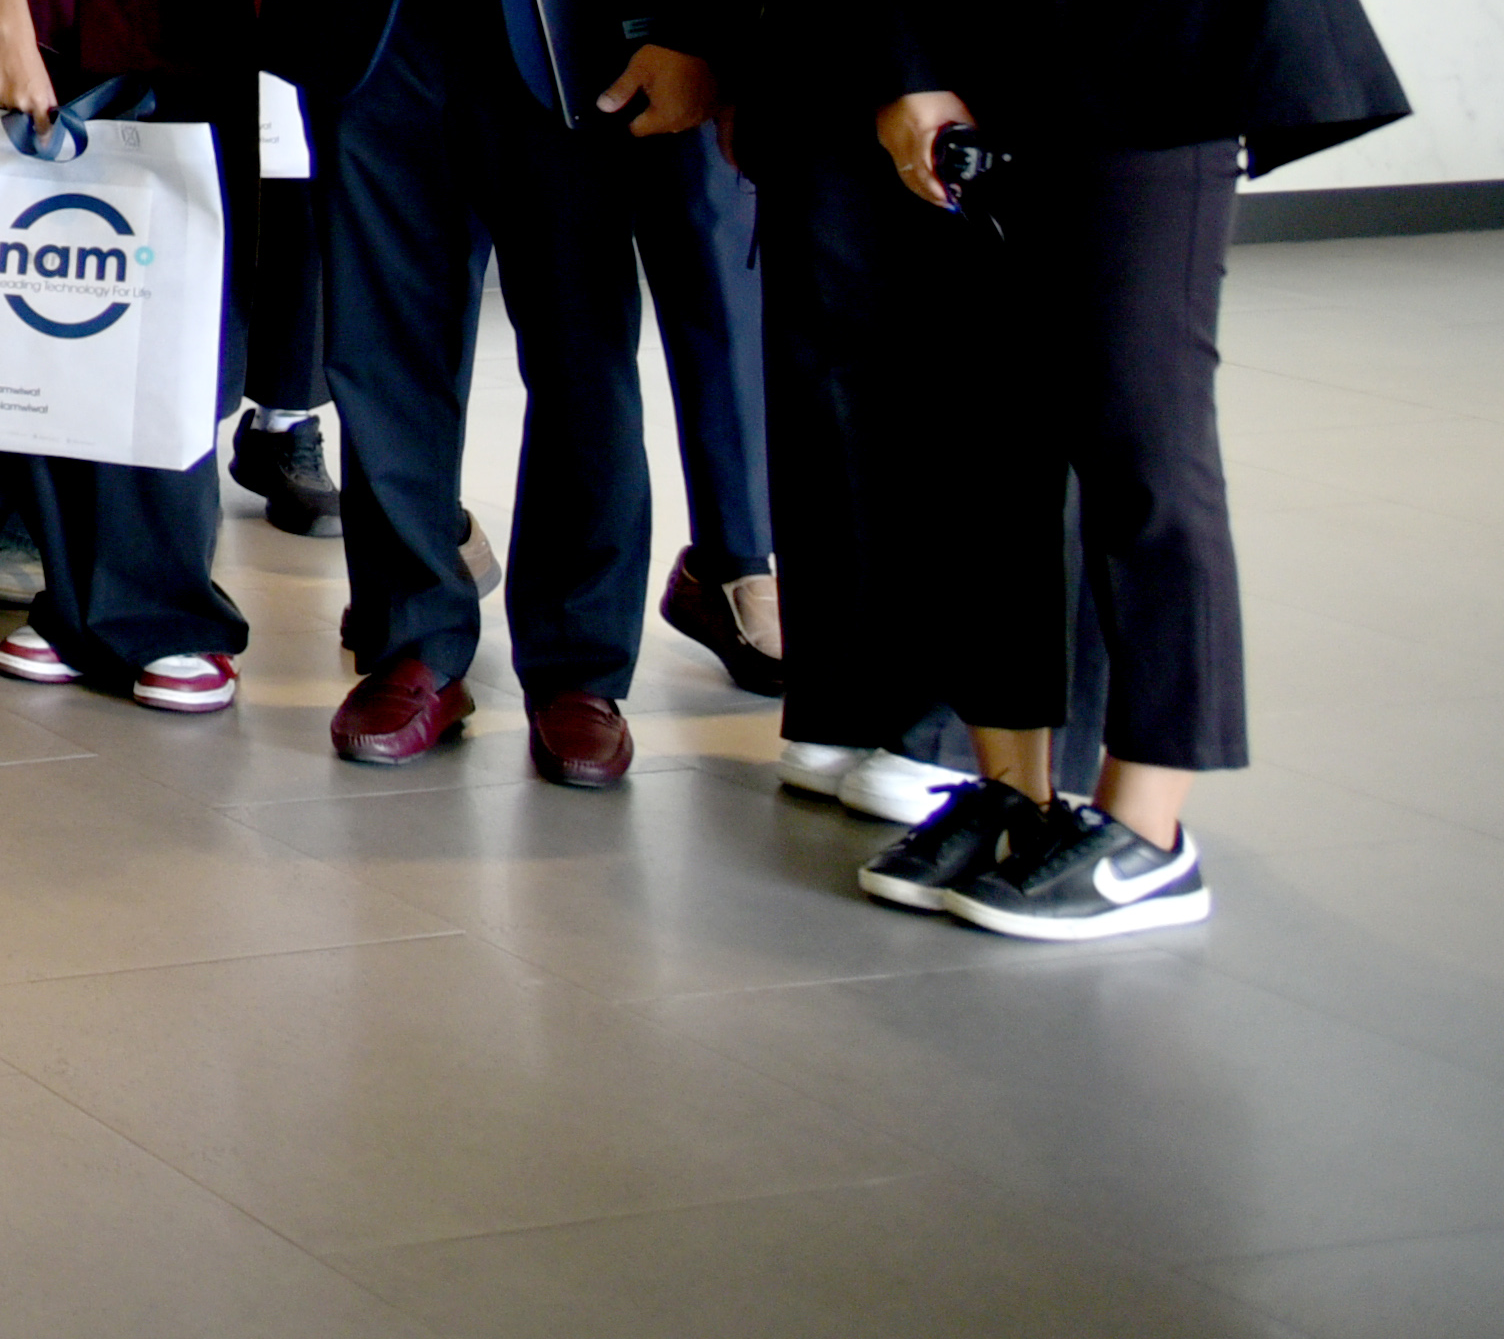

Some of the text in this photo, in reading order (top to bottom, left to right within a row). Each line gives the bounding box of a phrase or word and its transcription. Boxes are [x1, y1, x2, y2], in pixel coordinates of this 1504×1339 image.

[43, 280, 111, 298] Technology
[112, 286, 130, 297] For
[133, 287, 152, 300] Life
